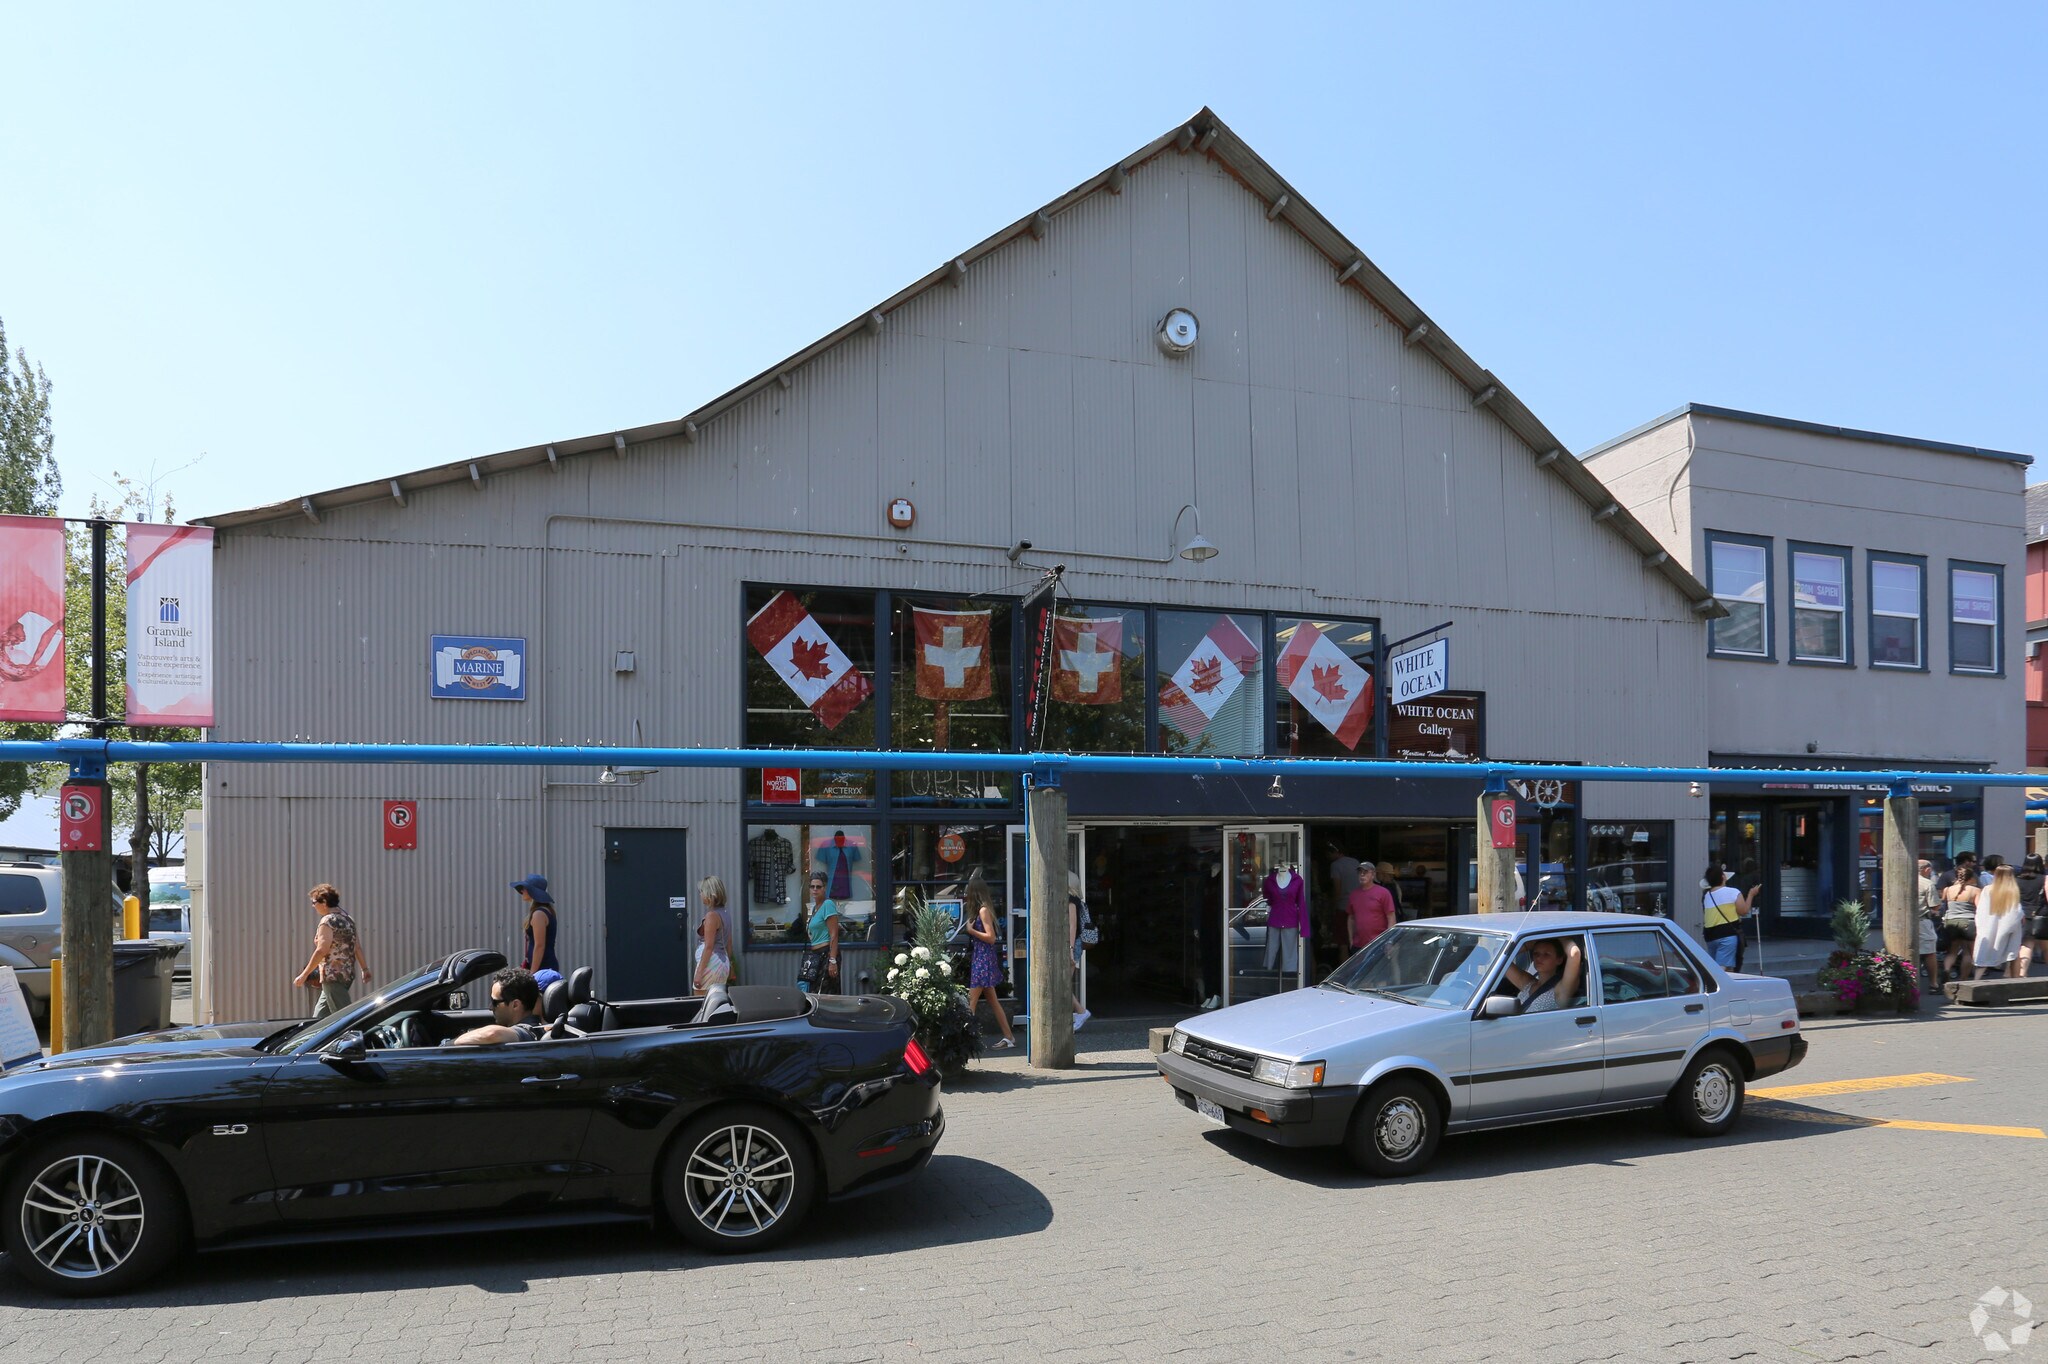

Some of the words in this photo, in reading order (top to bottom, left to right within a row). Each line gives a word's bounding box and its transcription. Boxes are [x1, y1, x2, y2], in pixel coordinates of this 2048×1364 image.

[146, 625, 192, 637] Granville
[154, 637, 185, 648] Island
[137, 653, 178, 661] Vancouver's
[1395, 649, 1434, 676] WHITE
[455, 661, 503, 674] MARINE
[1401, 669, 1443, 697] OCEAN
[1397, 704, 1434, 718] WHITE
[1436, 707, 1475, 720] OCEAN
[1418, 723, 1453, 740] Gallery
[213, 1124, 249, 1136] 5.0
